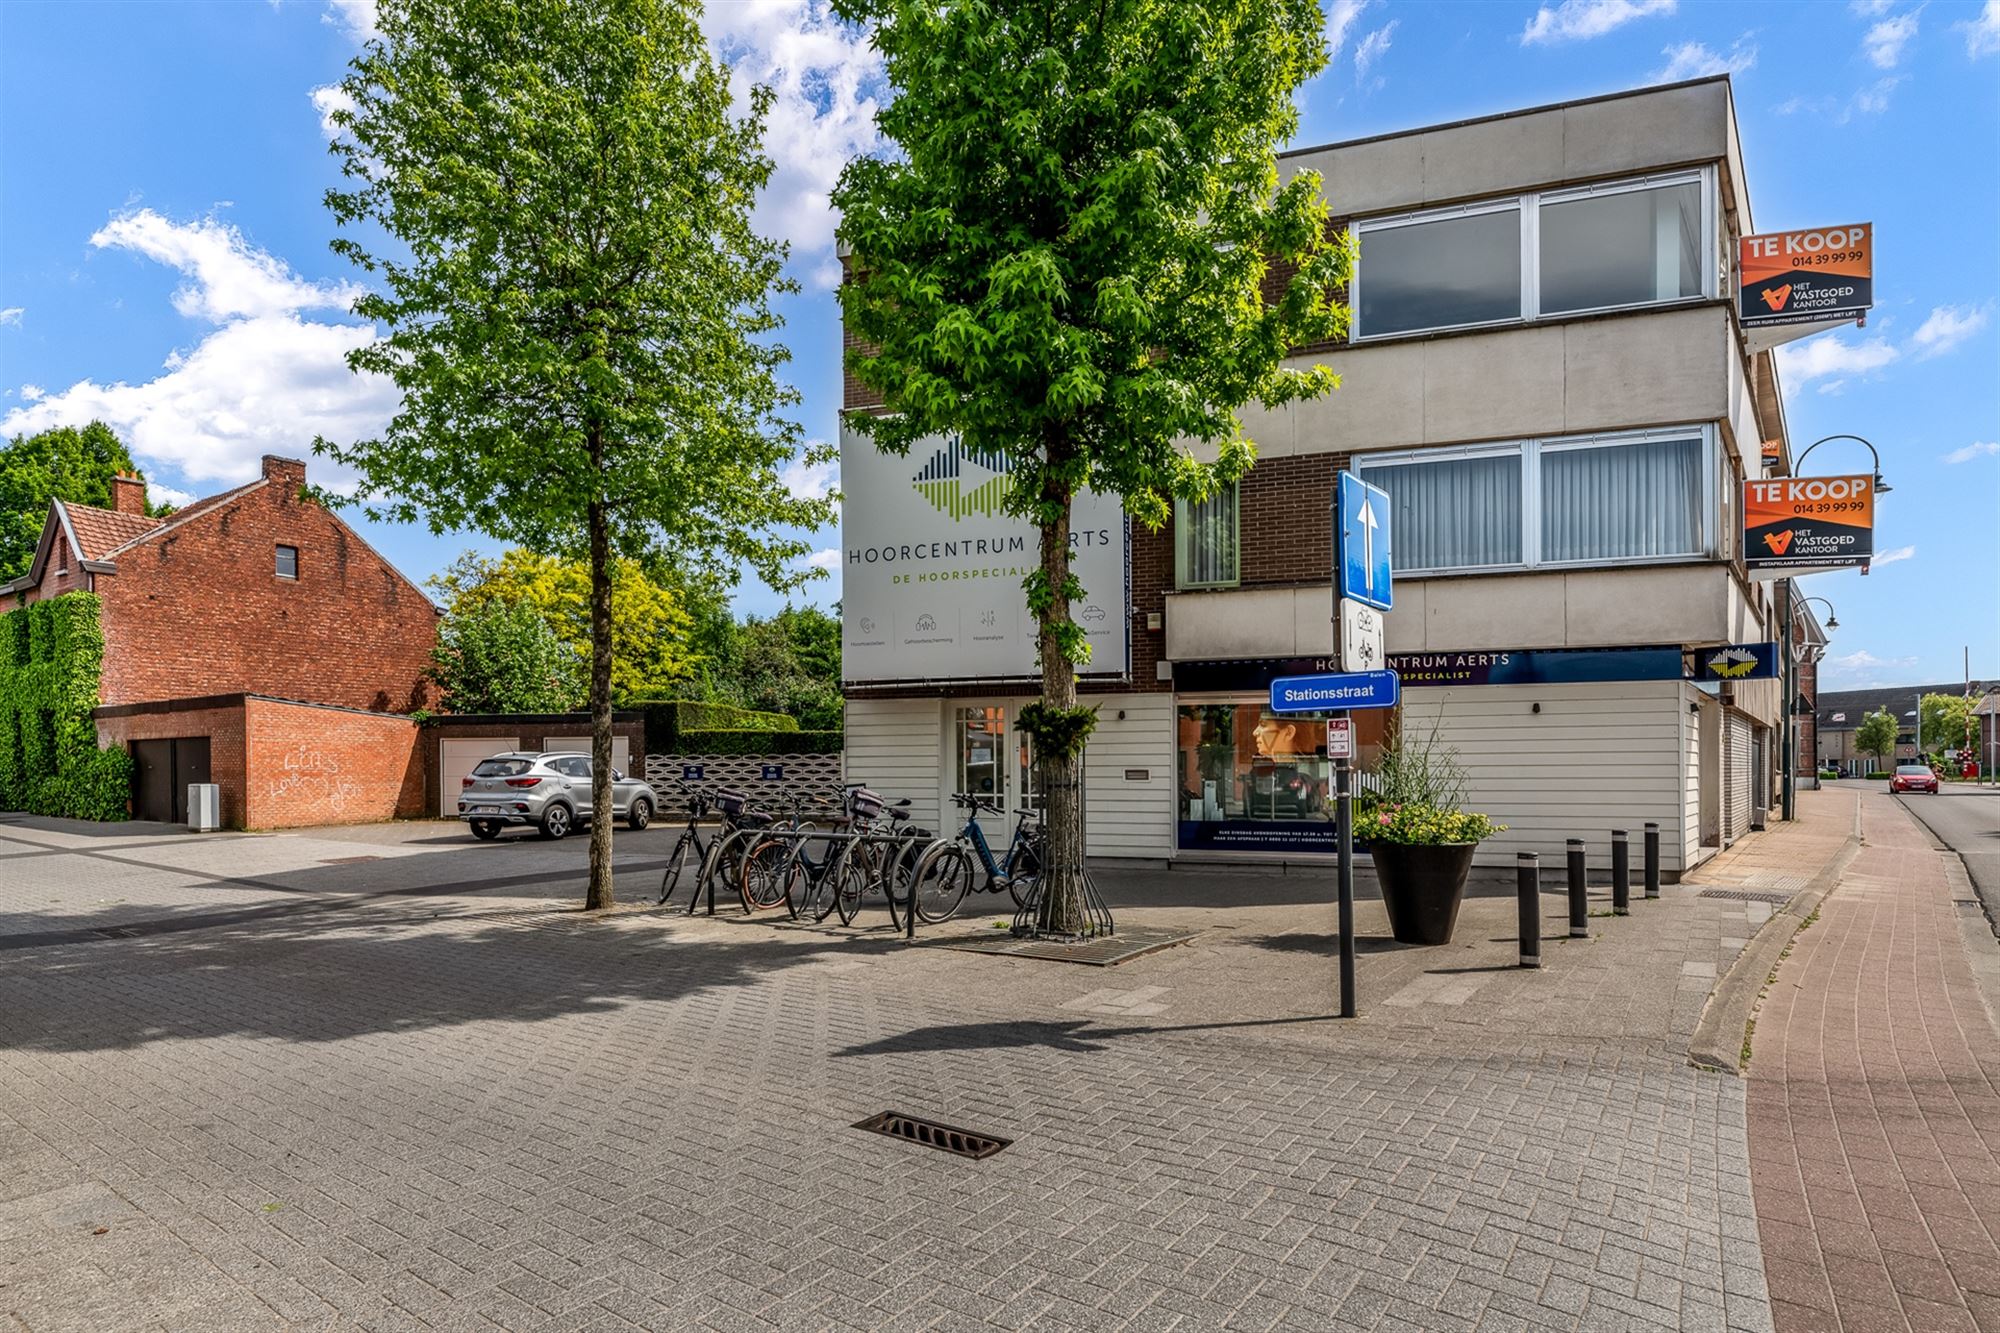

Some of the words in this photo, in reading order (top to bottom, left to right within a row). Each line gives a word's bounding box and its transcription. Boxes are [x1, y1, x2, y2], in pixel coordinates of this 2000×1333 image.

[1748, 237, 1779, 258] TE
[1785, 228, 1864, 255] KOOP
[1792, 256, 1812, 267] 014
[1816, 254, 1829, 265] 39
[1832, 252, 1846, 263] 99
[1848, 250, 1863, 261] 99
[1793, 282, 1810, 291] HET
[1793, 286, 1854, 300] VASTGOED
[1793, 298, 1837, 309] KANTOOR
[1775, 315, 1813, 324] APPARTEMENT
[1752, 482, 1782, 503] TE
[1788, 479, 1867, 501] KOOP
[1794, 504, 1814, 513] 014
[1817, 503, 1830, 512] 39
[1833, 502, 1847, 512] 99
[1849, 501, 1864, 511] 99
[1795, 529, 1811, 537] HET
[1794, 535, 1855, 546] VASTGOED
[849, 536, 1024, 564] HOORCENTRUM
[1795, 545, 1838, 554] KANTOOR
[893, 575, 910, 584] DE
[1456, 653, 1510, 666] AERTS
[1284, 684, 1374, 702] Stationsstraat
